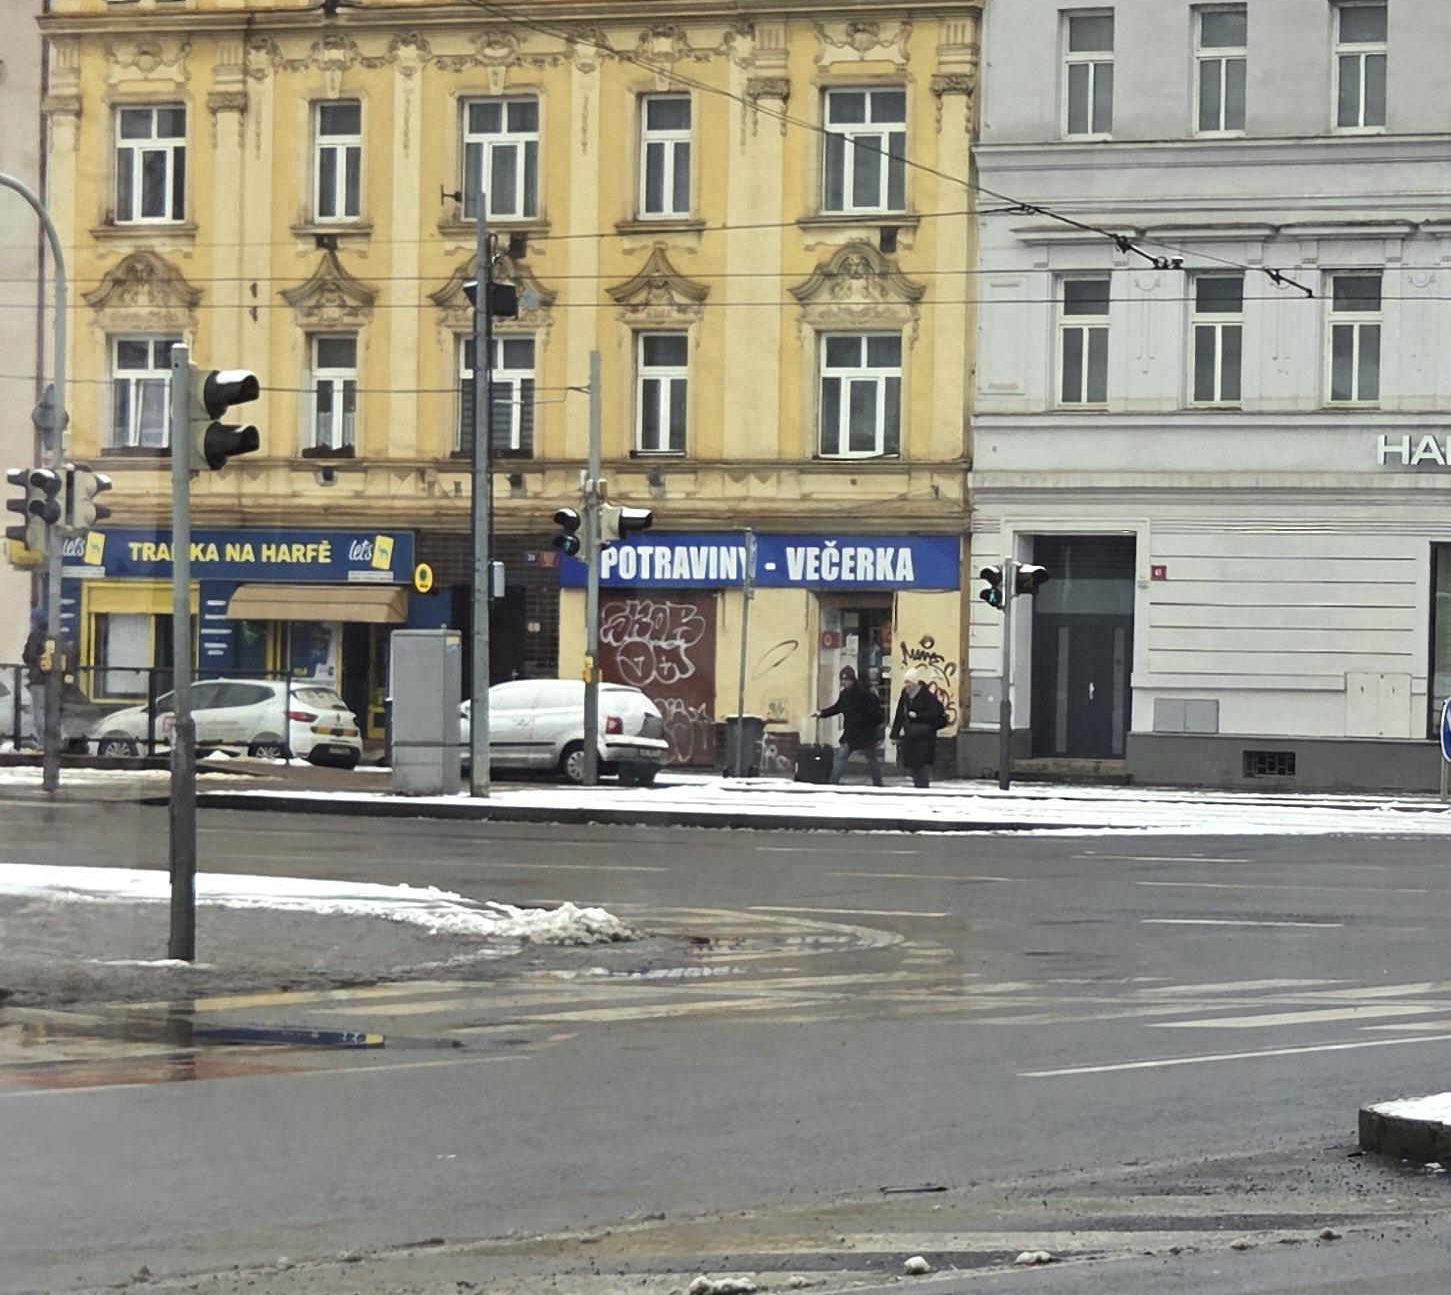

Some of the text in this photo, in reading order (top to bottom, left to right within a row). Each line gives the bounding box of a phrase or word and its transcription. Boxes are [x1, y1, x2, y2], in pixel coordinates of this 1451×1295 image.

[128, 540, 332, 564] TRAKA NA HARFĚ
[785, 540, 915, 582] VEČERKA
